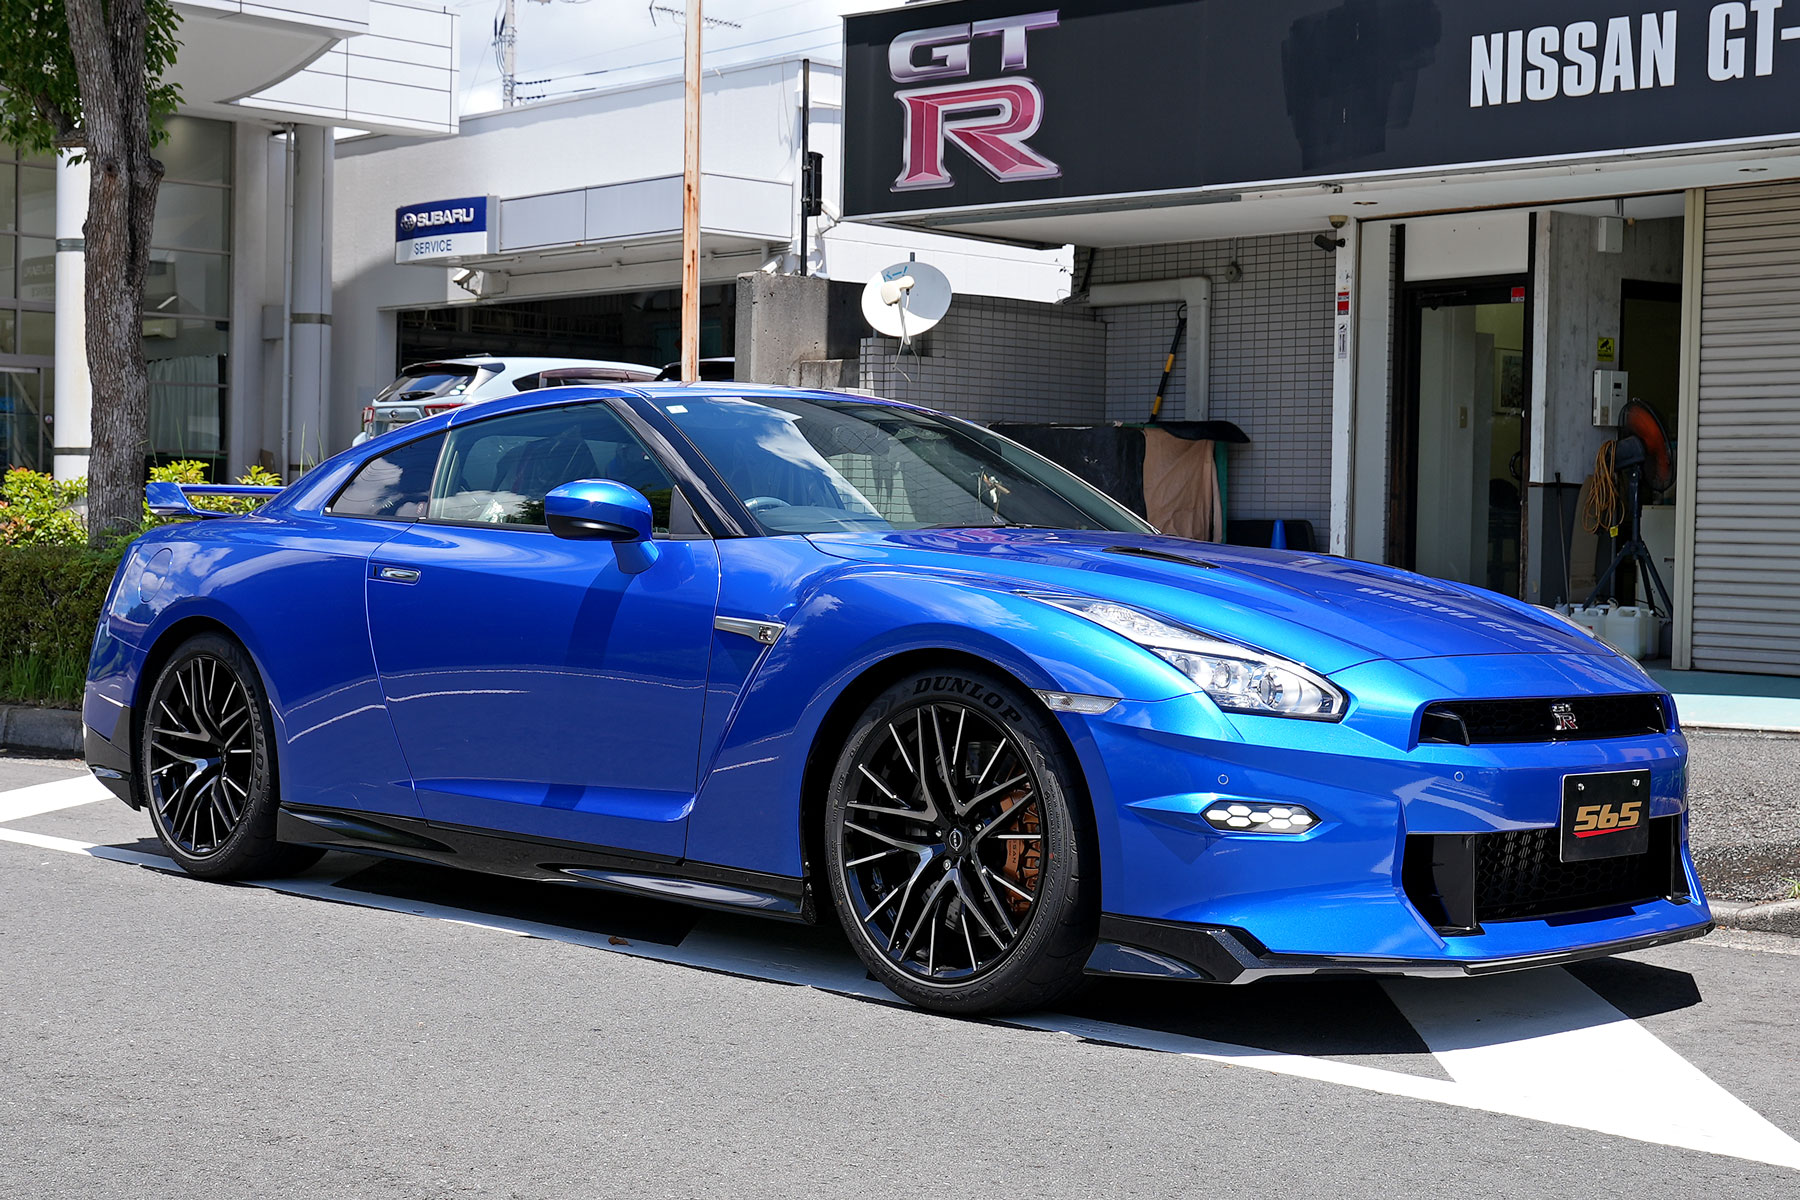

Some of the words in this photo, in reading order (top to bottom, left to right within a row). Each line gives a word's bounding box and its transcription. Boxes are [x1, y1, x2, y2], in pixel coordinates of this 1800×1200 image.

[888, 9, 1060, 83] GT
[1469, 9, 1678, 108] NISSAN
[889, 76, 1062, 193] R
[416, 207, 475, 228] SUBARU
[414, 239, 452, 255] SERVICE
[912, 675, 1023, 723] DUNLOP
[1553, 712, 1579, 731] R
[245, 683, 265, 793] DUNLOP
[1573, 801, 1643, 832] 565
